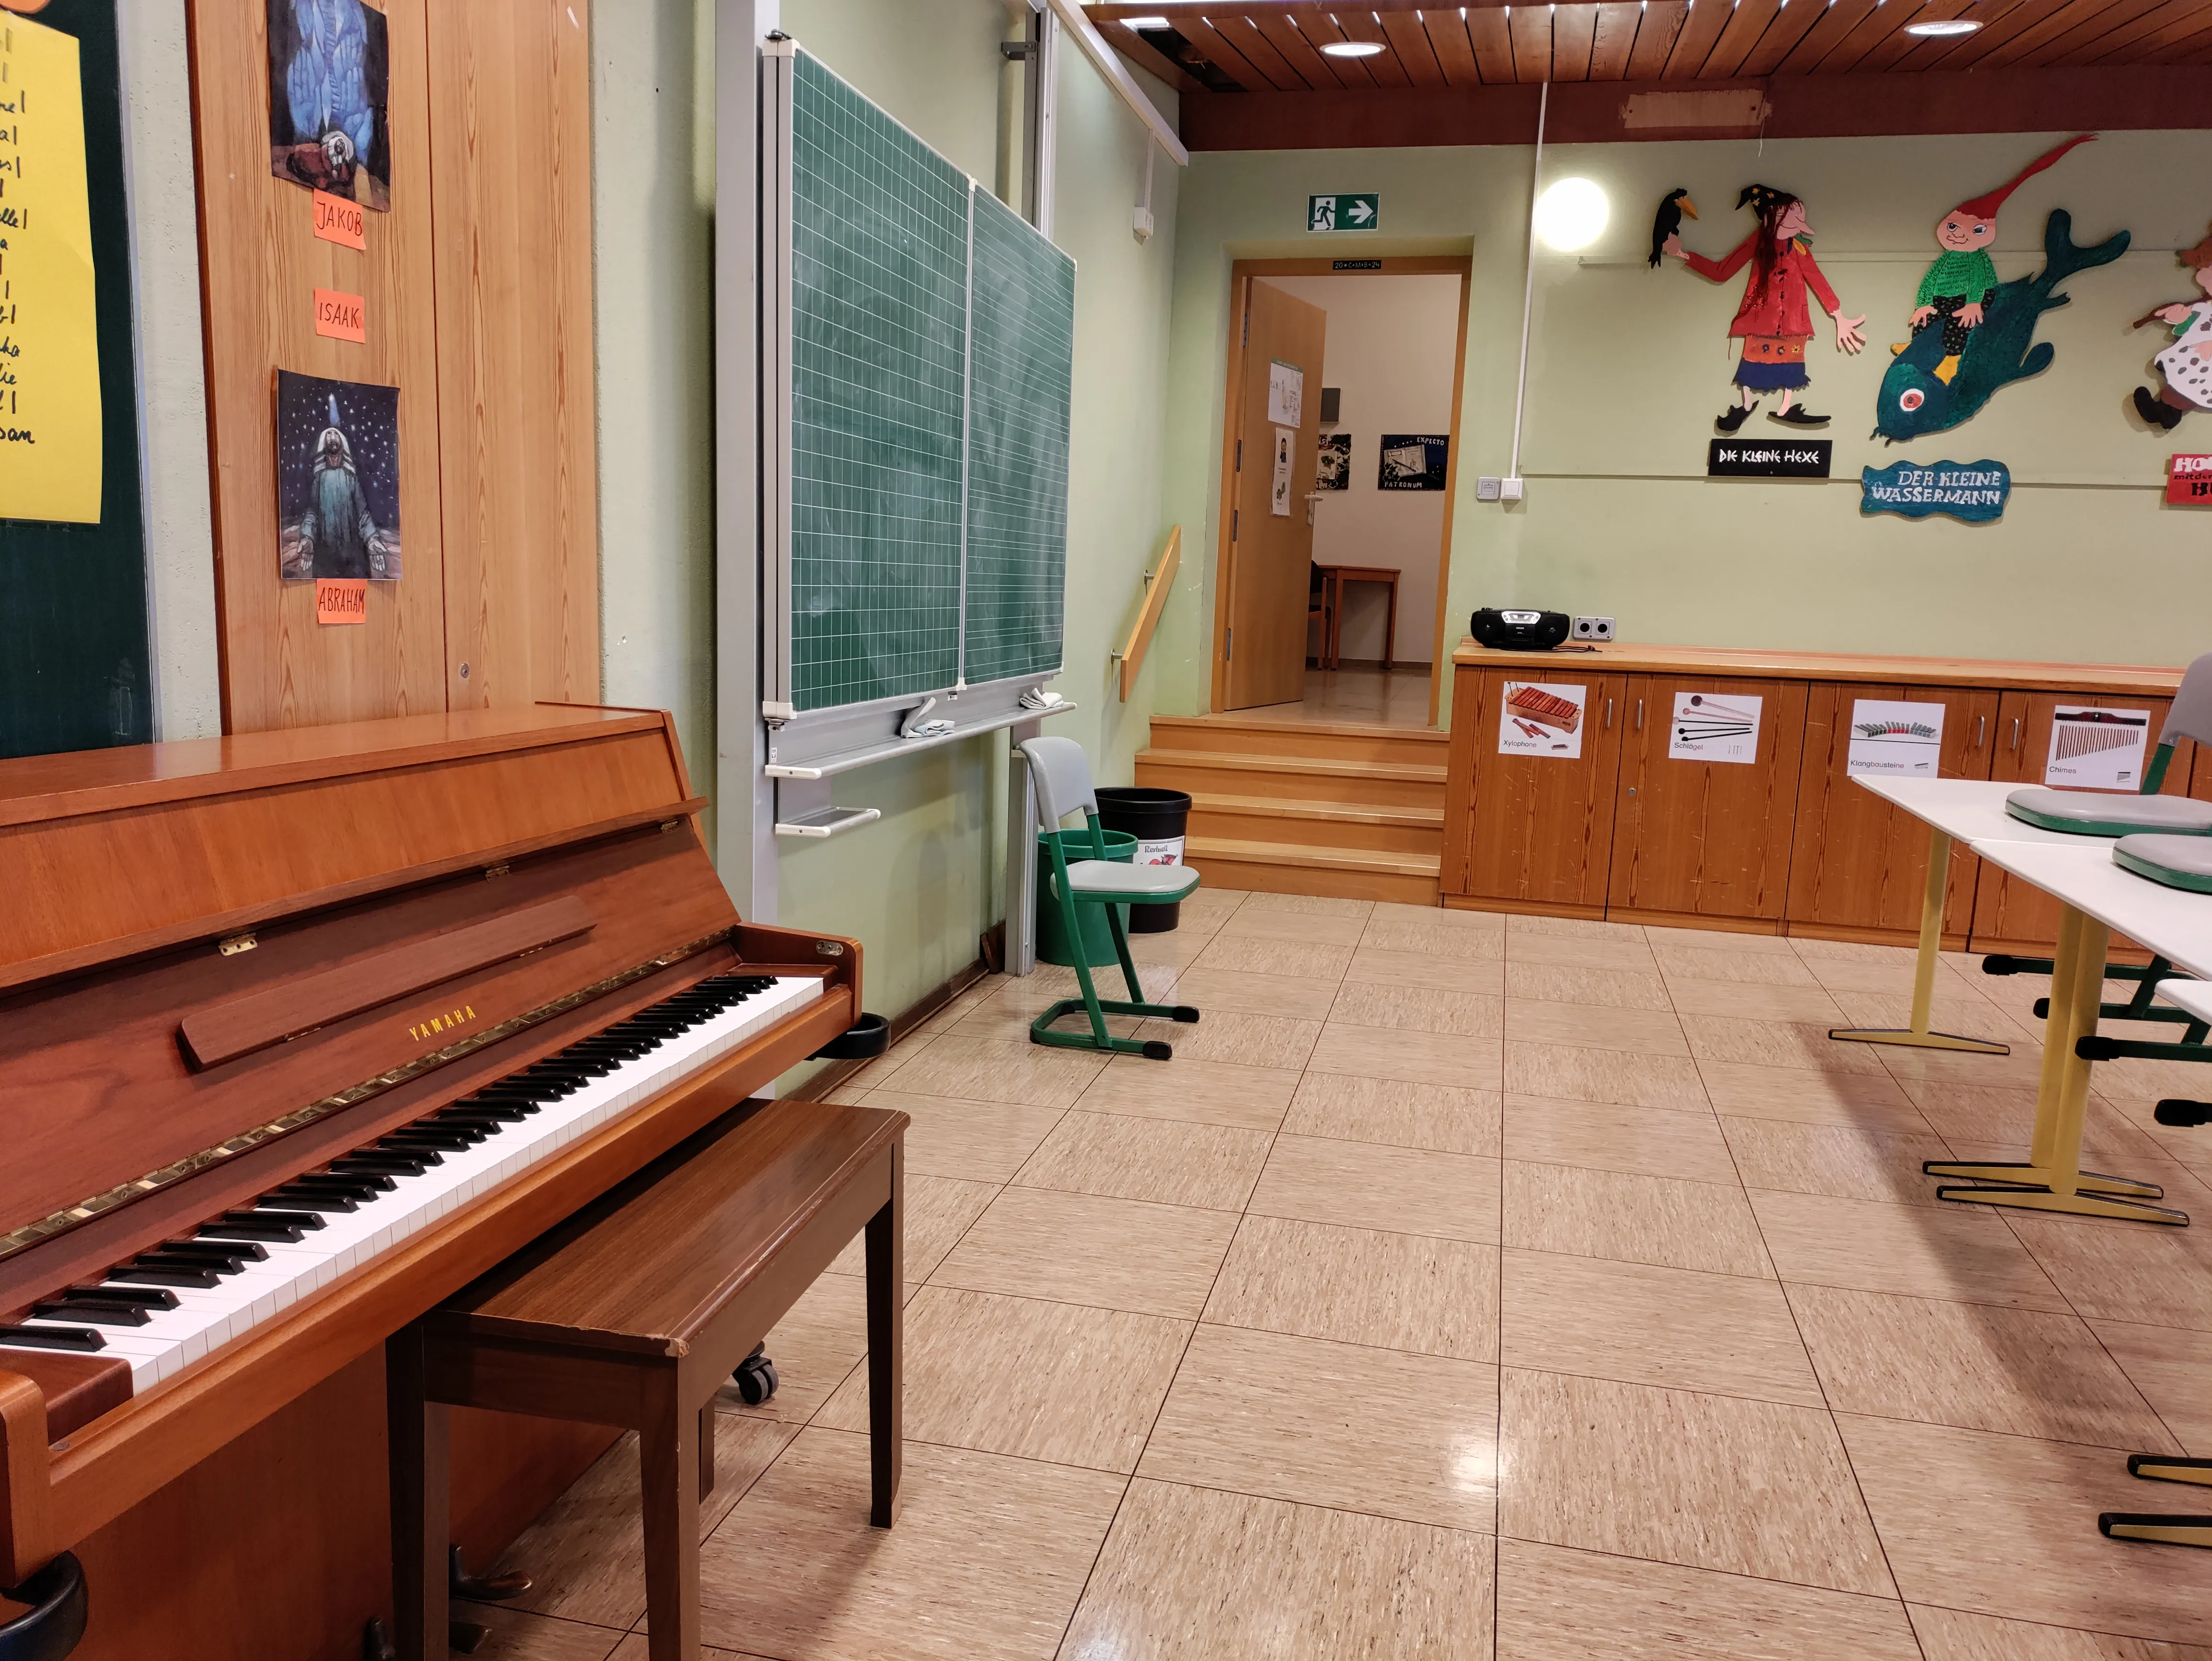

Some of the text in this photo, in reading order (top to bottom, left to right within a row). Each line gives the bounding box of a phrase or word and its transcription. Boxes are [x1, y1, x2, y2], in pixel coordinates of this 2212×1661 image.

[316, 201, 363, 236] JAKOB
[320, 302, 359, 329] ISAAK
[1417, 437, 1444, 446] EXPECTO
[1719, 449, 1819, 464] DIE KLEINE HEXE
[1898, 471, 2002, 487] DER KLEINE
[1871, 487, 2001, 505] WASSERMANN
[318, 587, 365, 614] ABRAHAM
[1503, 740, 1537, 748] Xylophone
[1674, 742, 1703, 751] Schlägel
[1850, 760, 1904, 769] Klangbausteine
[409, 1006, 476, 1041] YAMAHA
